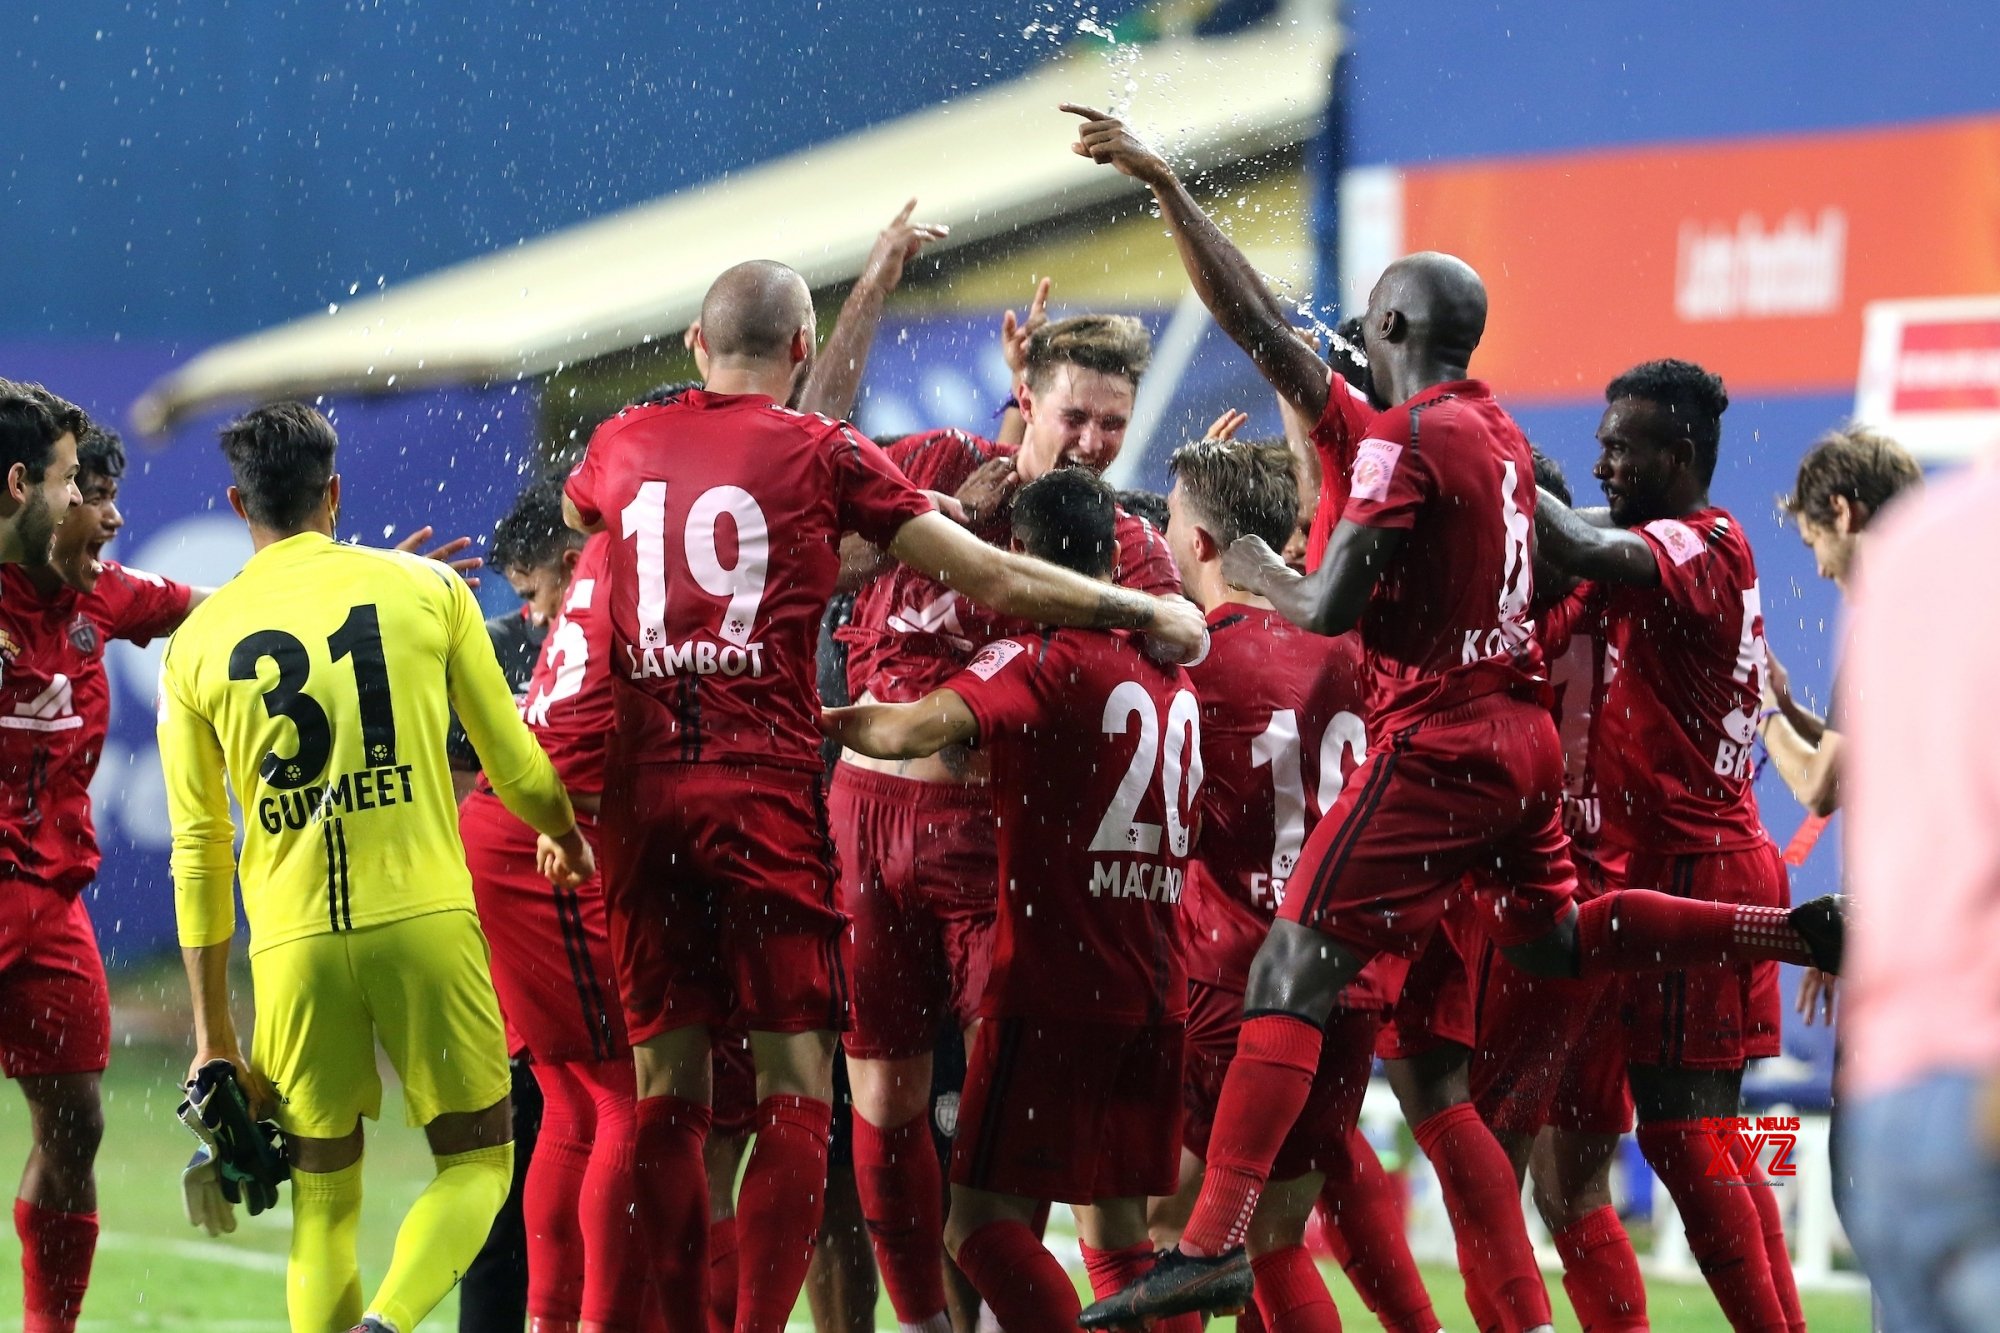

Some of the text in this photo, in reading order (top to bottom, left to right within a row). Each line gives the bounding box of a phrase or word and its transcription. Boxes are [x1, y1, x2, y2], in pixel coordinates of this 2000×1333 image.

[621, 481, 769, 649] 19
[229, 603, 397, 789] 31
[626, 640, 764, 680] LAMBOT
[258, 764, 412, 835] GURMEET
[1087, 680, 1203, 858] 20
